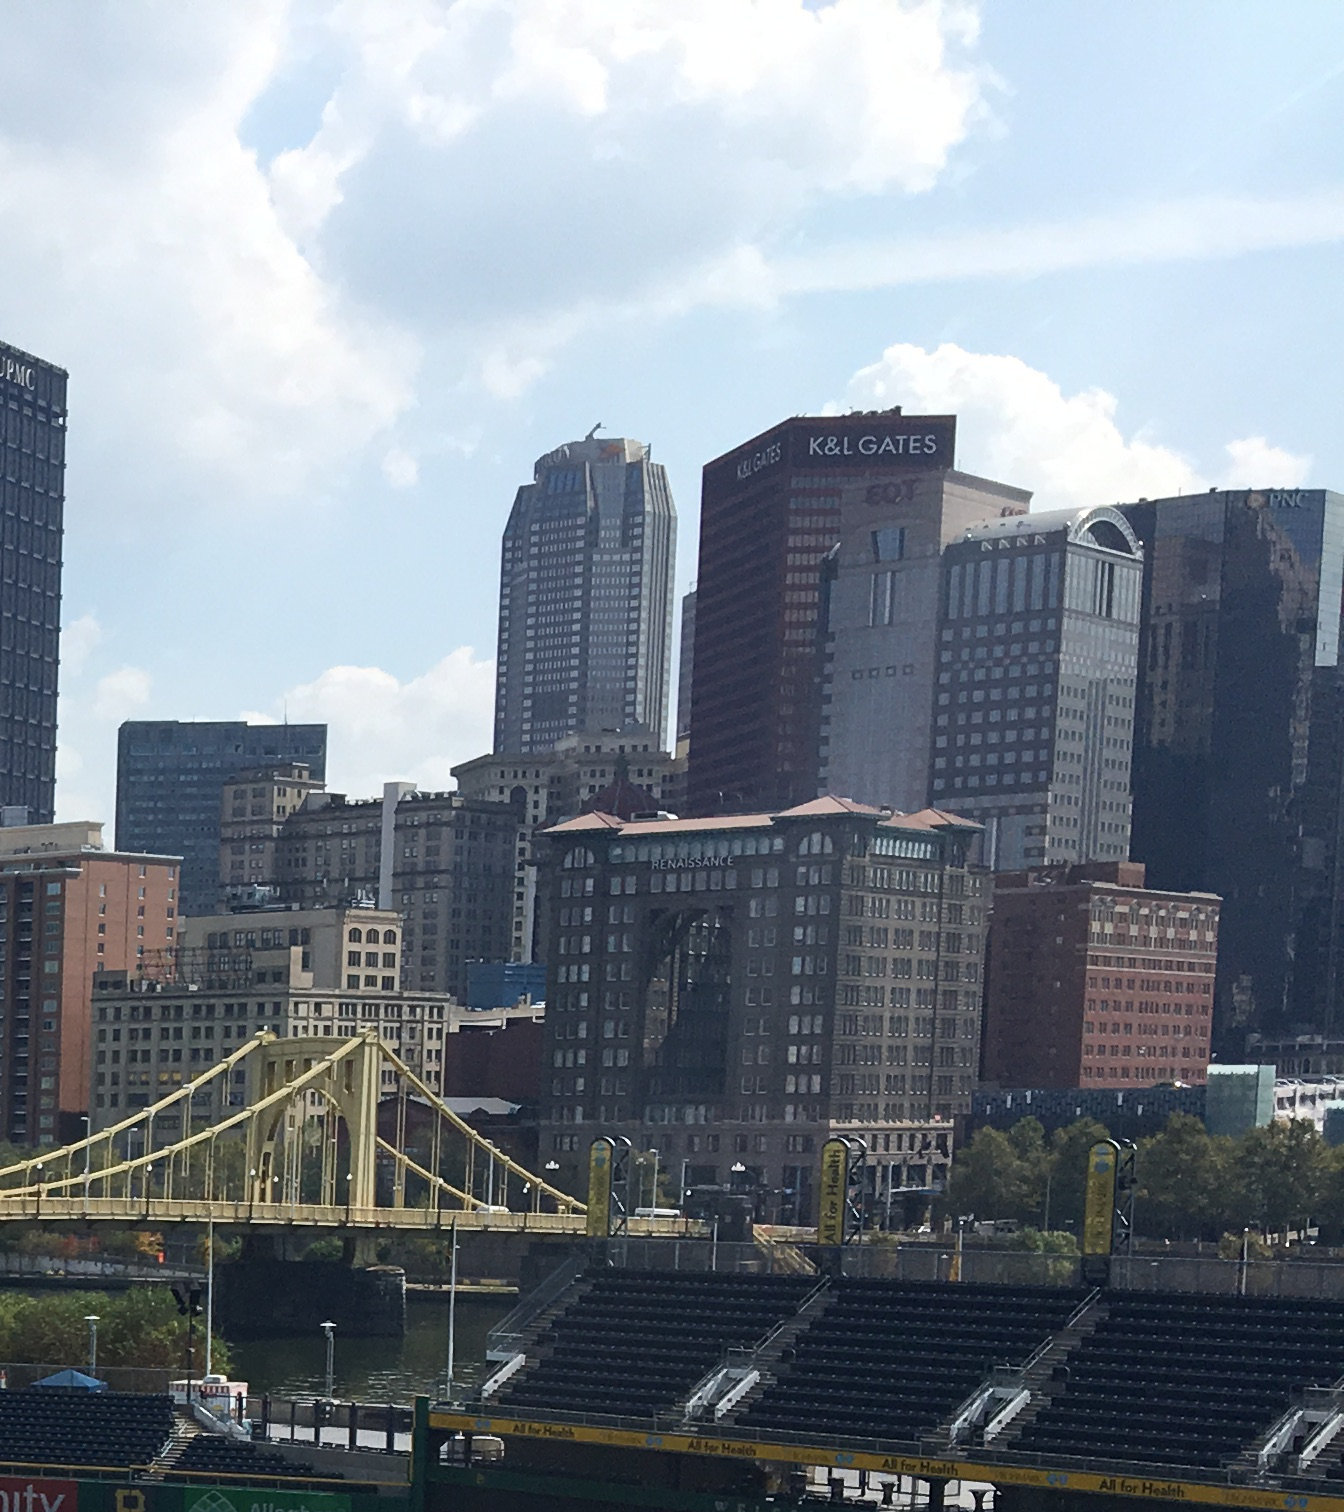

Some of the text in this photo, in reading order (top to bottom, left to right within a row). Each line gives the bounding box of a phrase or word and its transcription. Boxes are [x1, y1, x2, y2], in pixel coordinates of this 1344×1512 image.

[809, 434, 937, 456] K&L GATES
[753, 442, 782, 473] GATES
[1269, 491, 1307, 508] PNC
[652, 855, 734, 870] RENAISSANCE
[881, 1458, 958, 1476] All for Health
[1099, 1477, 1185, 1498] All for Health
